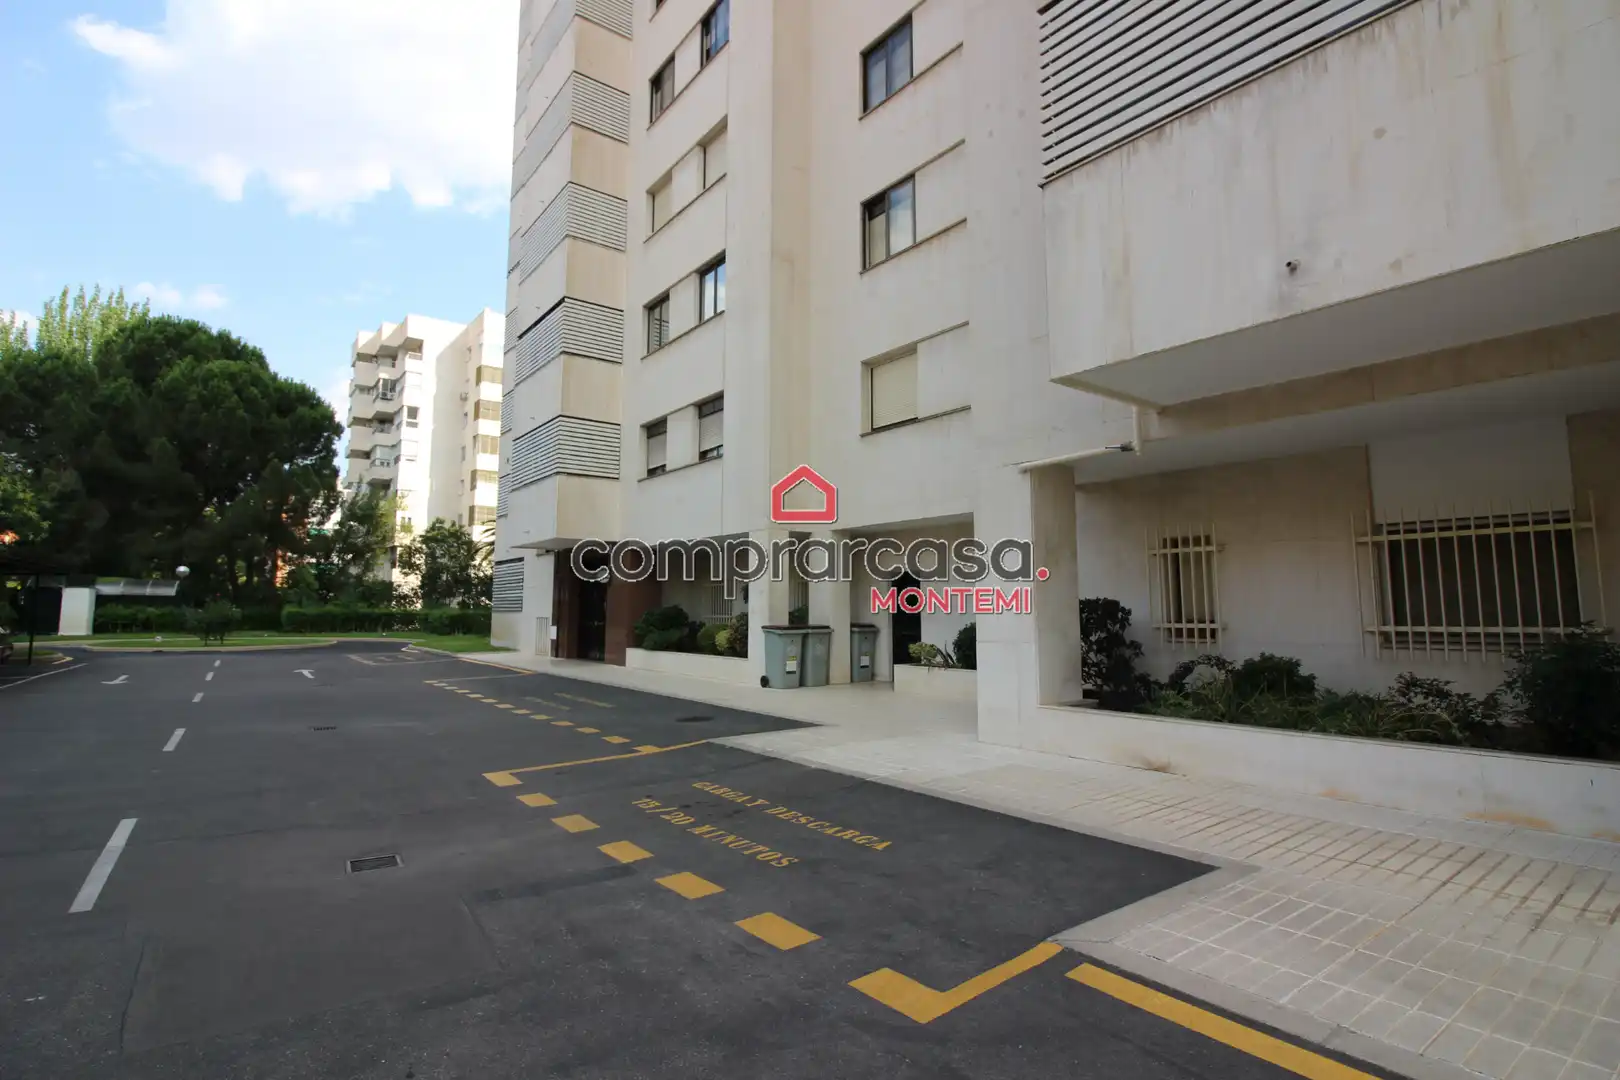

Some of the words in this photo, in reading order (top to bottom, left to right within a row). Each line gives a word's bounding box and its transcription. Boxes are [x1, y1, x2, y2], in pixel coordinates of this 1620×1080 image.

[691, 781, 752, 803] CARGA
[743, 798, 771, 807] Y
[762, 806, 892, 851] DESCARGA
[686, 824, 799, 868] MINUTOS
